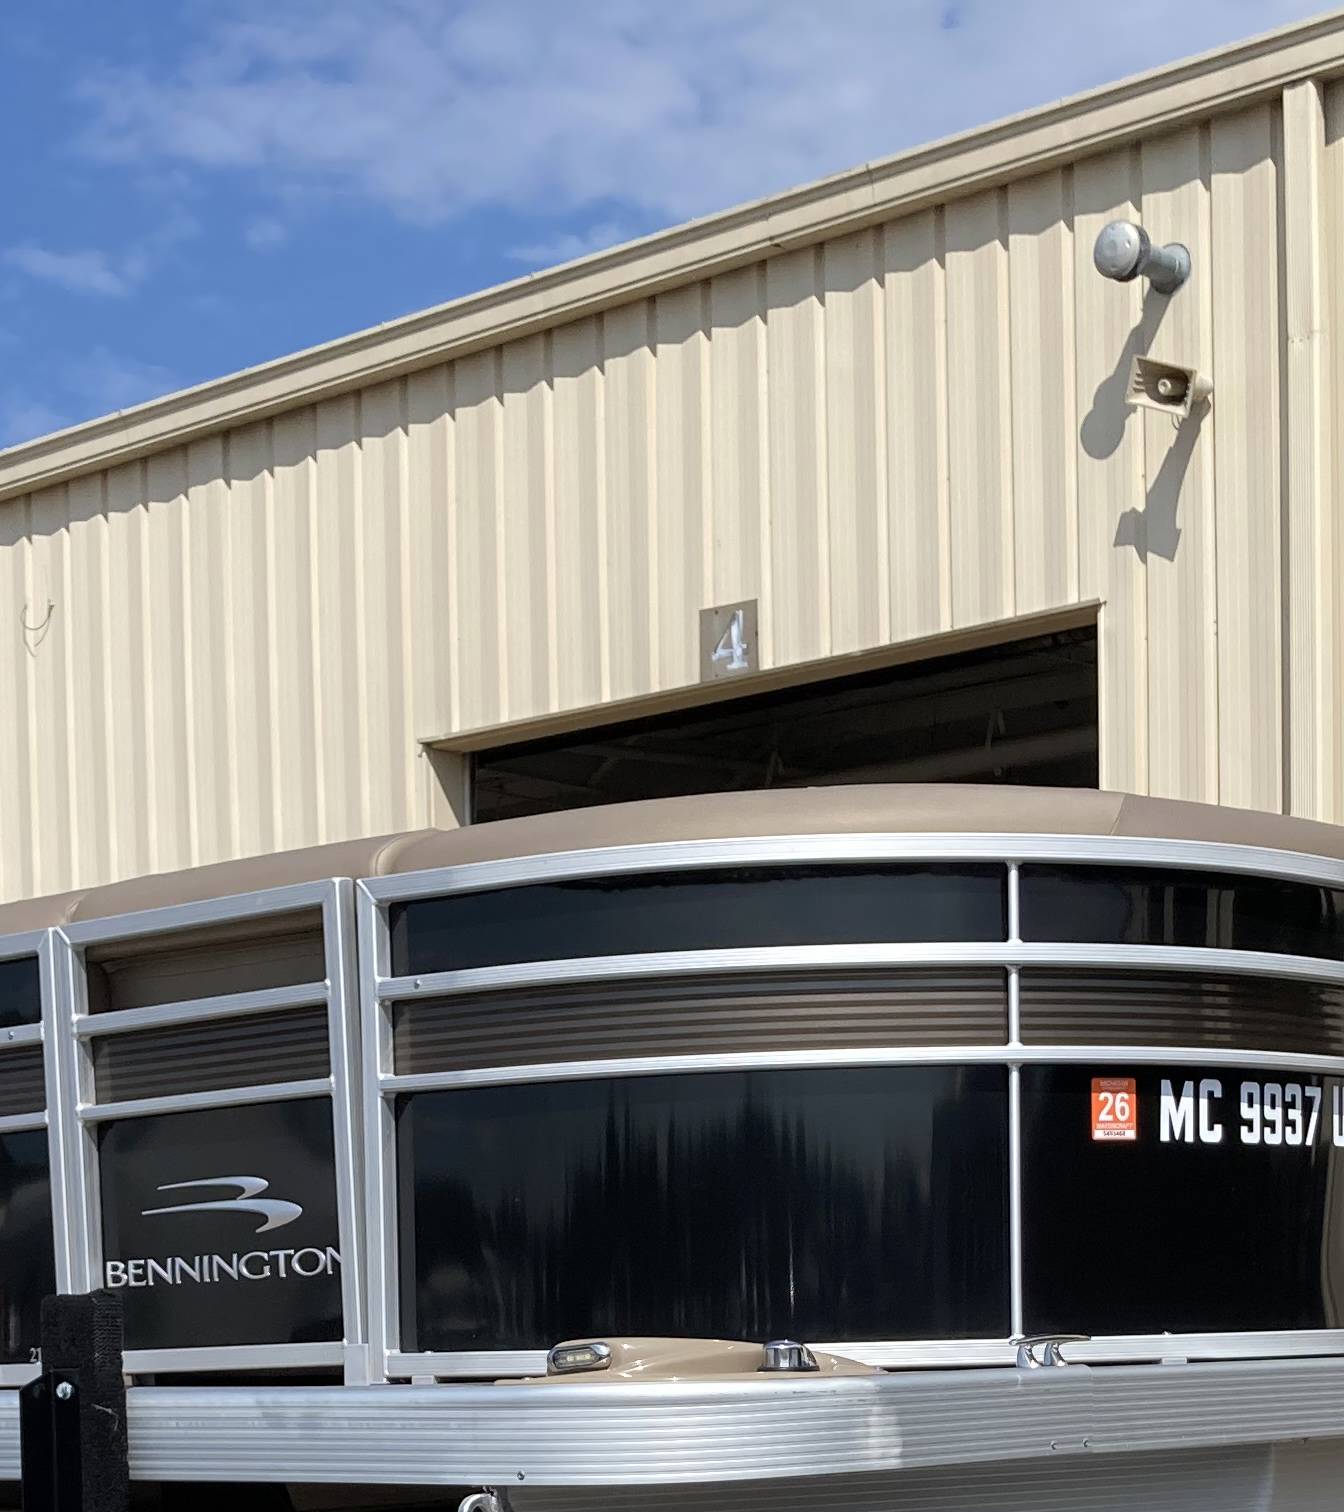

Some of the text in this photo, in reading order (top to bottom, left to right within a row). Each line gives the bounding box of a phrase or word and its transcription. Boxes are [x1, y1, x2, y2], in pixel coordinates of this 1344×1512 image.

[712, 609, 748, 669] 4
[1099, 1091, 1130, 1122] 26
[1160, 1078, 1223, 1142] MC
[1240, 1081, 1321, 1146] 9937
[106, 1247, 344, 1289] BENNINGTON
